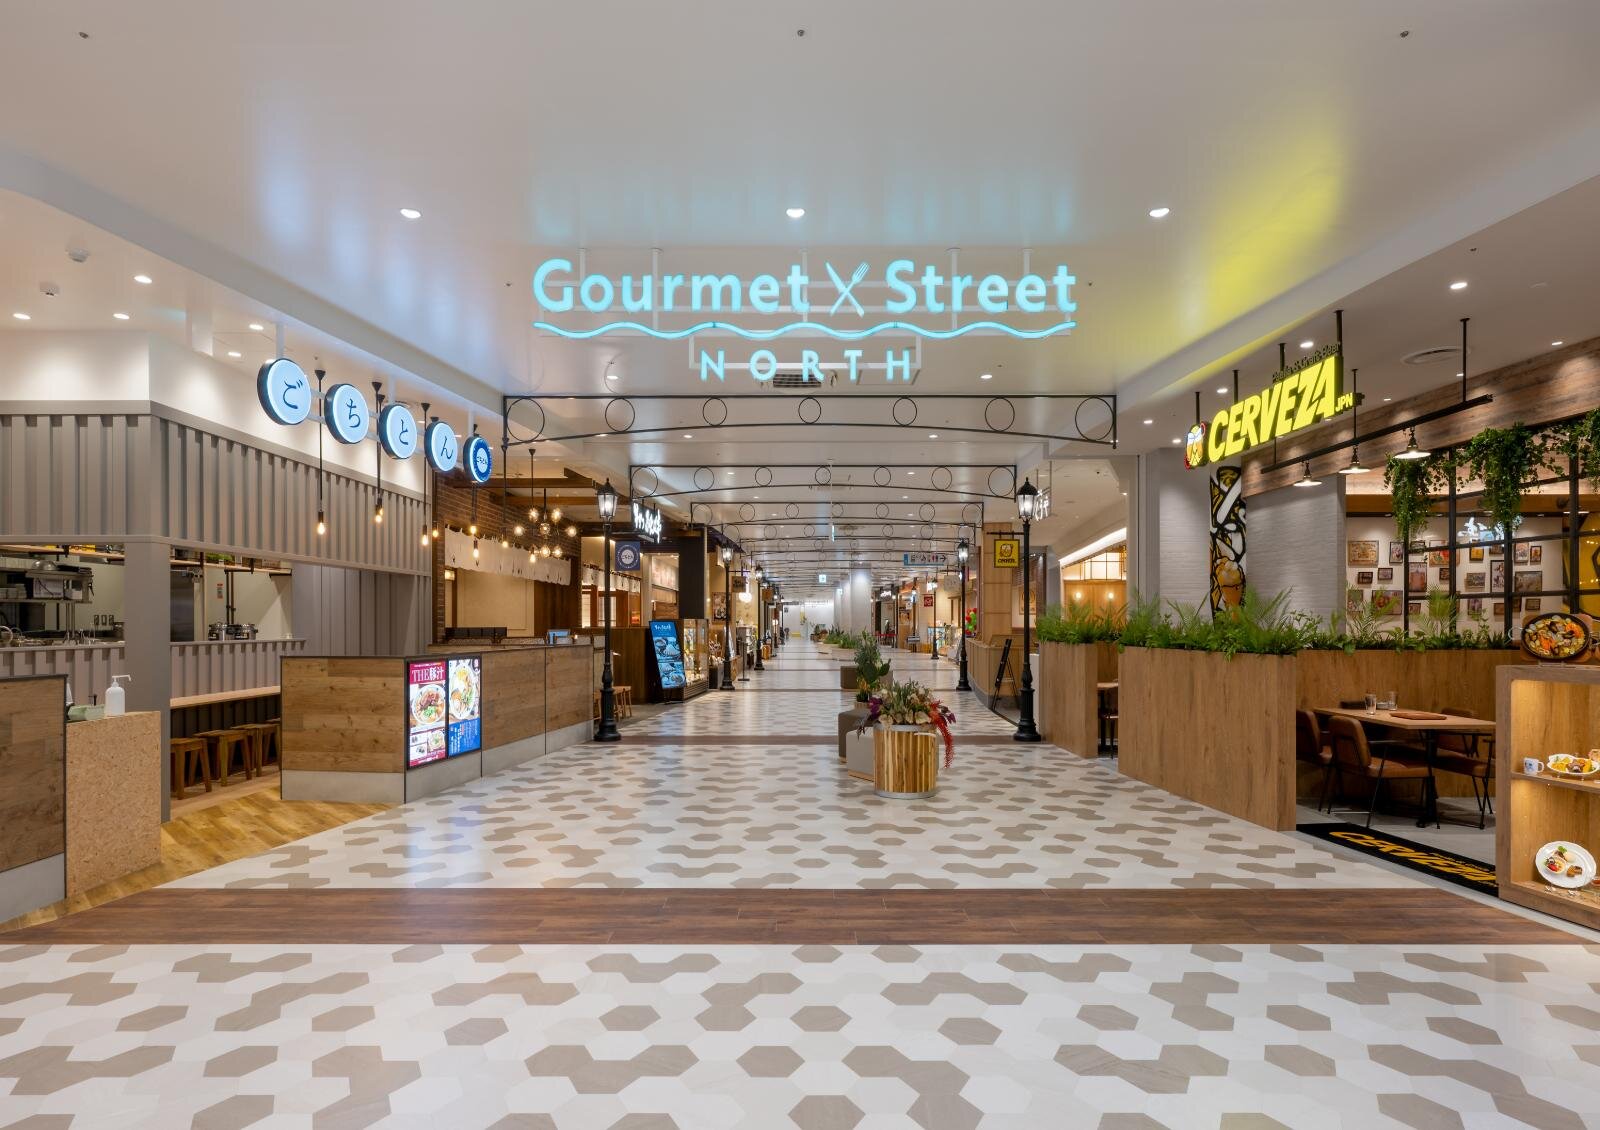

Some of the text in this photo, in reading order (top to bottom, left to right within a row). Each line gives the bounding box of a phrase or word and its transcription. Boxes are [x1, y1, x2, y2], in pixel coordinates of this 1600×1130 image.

[533, 258, 1077, 314] Gourmet Street
[700, 349, 911, 382] NORTH
[283, 379, 454, 460] ごちとん
[1208, 356, 1335, 463] CERVEZA
